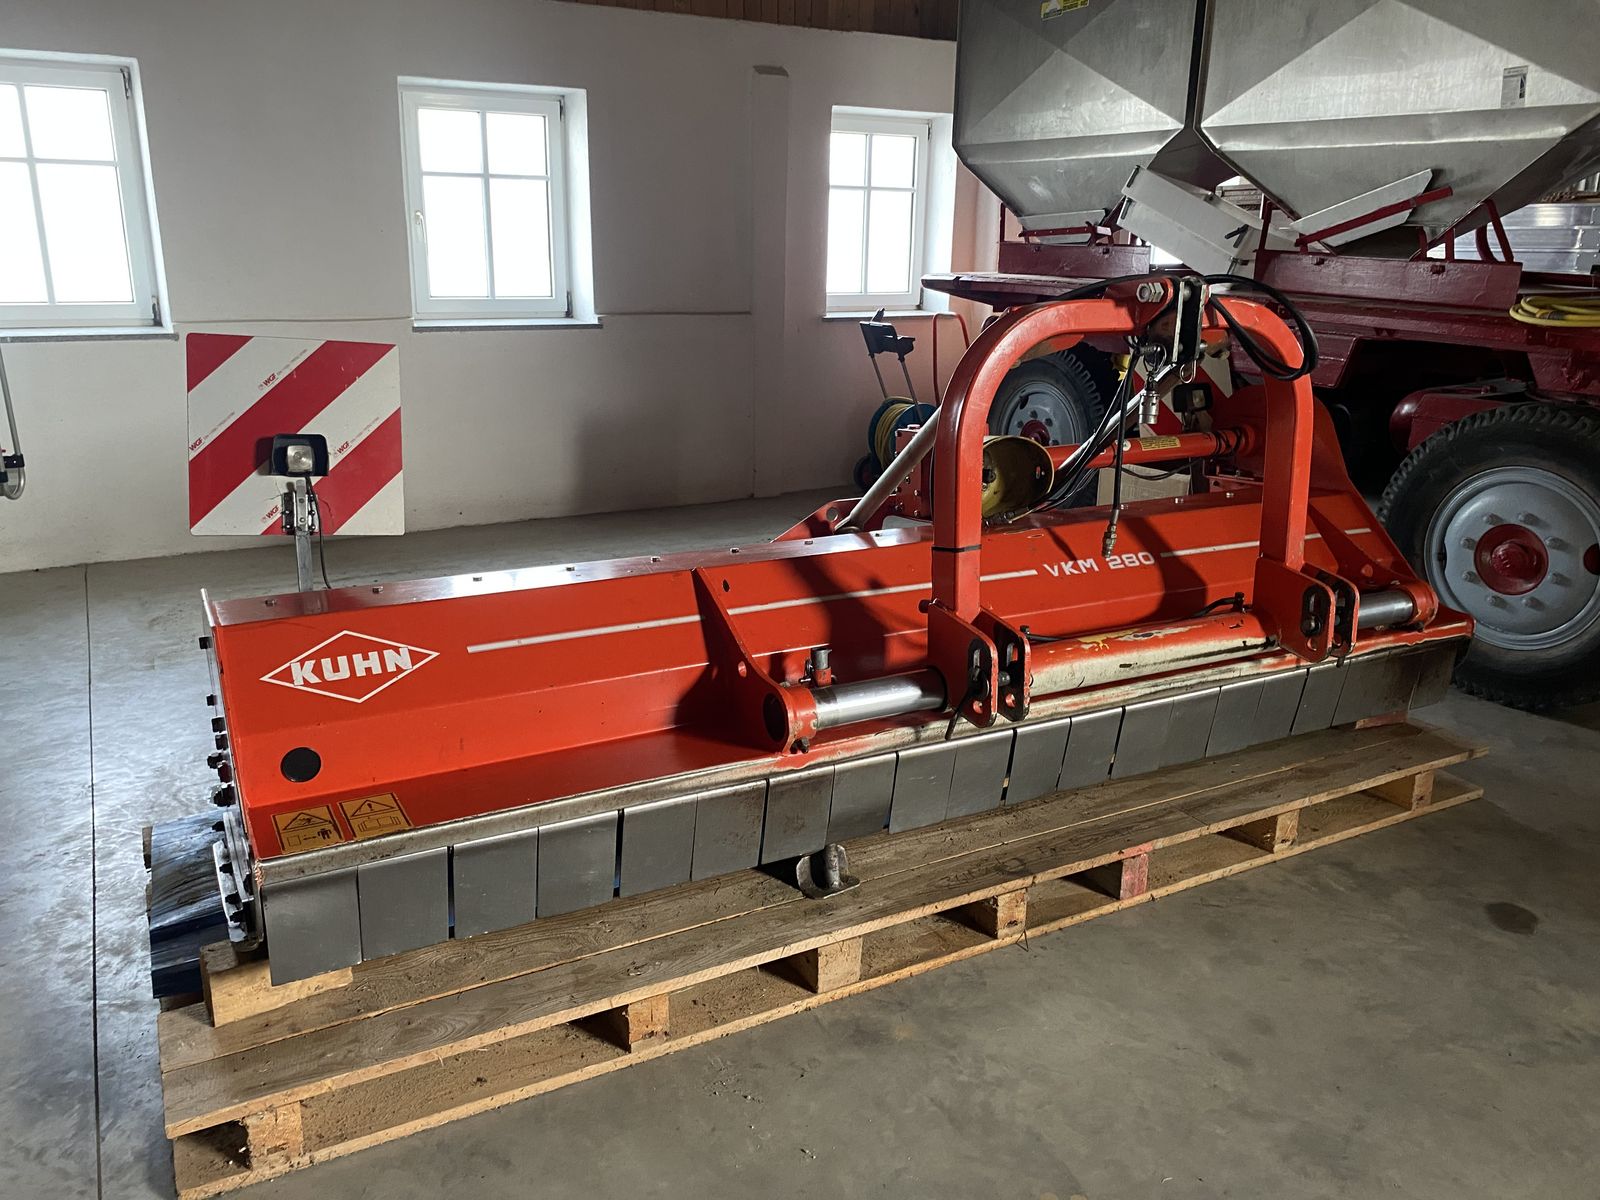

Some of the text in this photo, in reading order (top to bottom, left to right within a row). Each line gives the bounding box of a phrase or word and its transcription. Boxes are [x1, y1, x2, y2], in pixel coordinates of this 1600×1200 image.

[262, 373, 277, 386] WGF
[189, 437, 203, 451] WGF
[336, 441, 350, 454] WGF
[265, 505, 280, 519] WGF
[1043, 551, 1155, 577] VKM 280
[290, 647, 413, 687] KUHN
